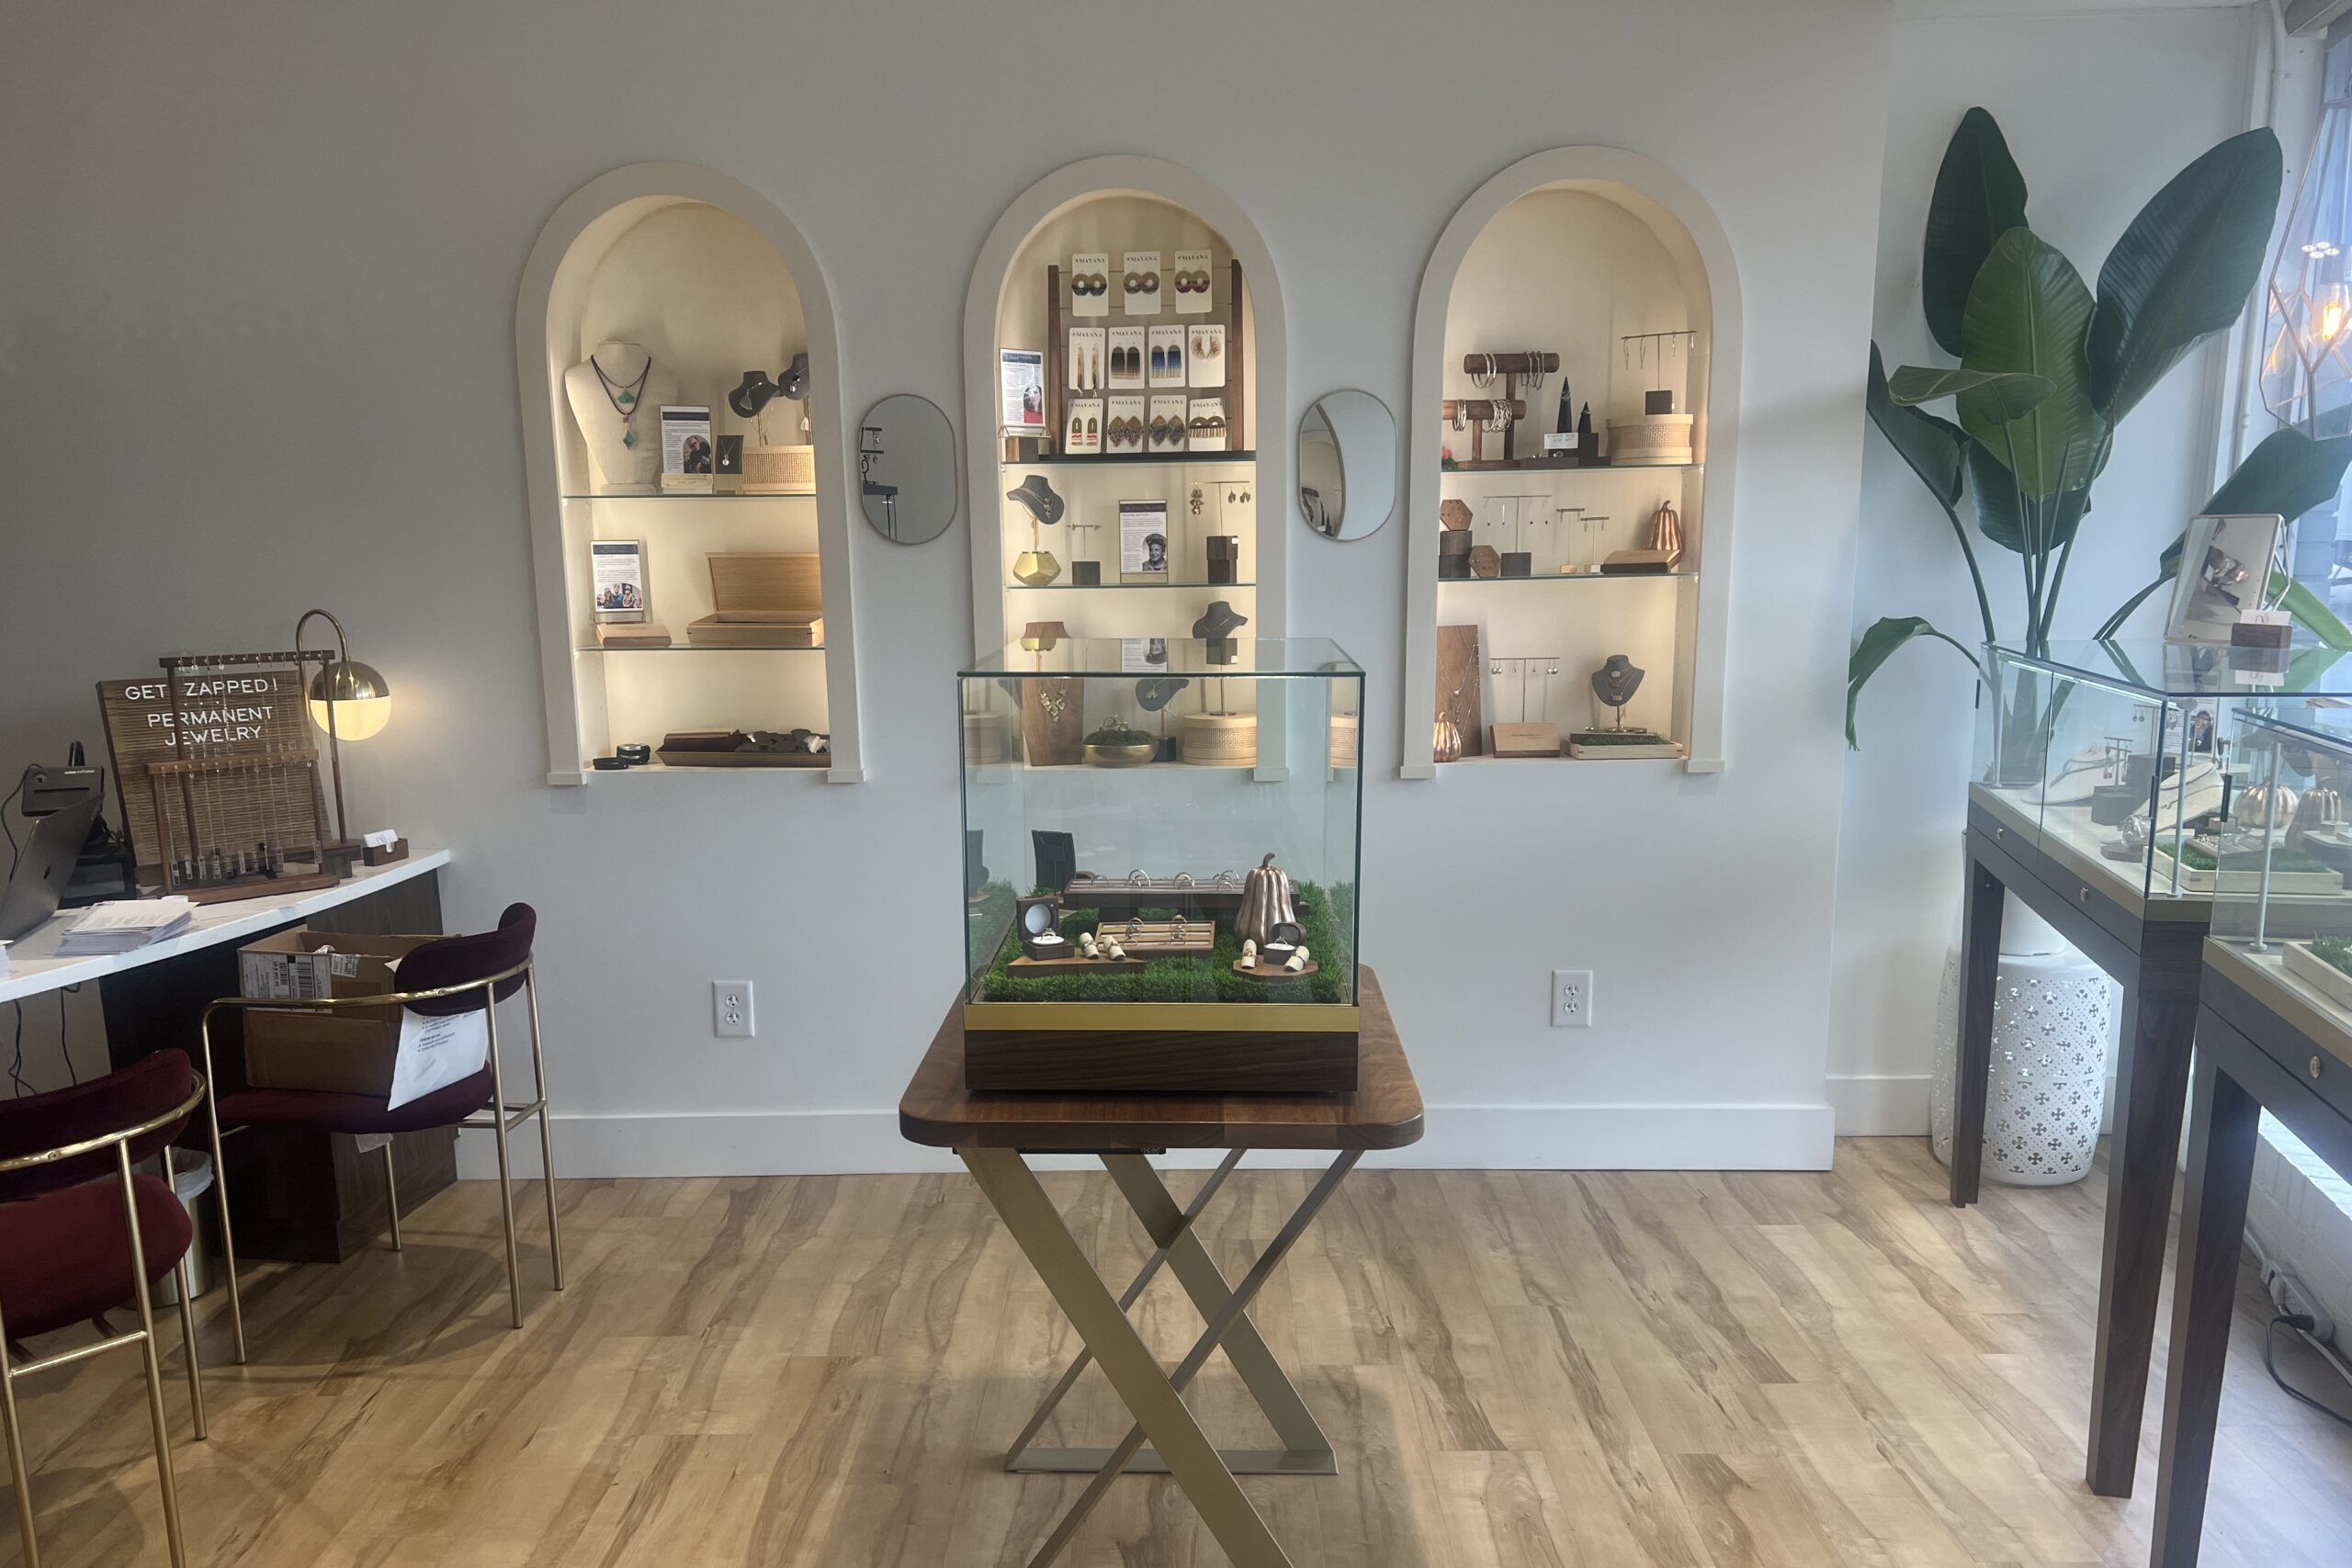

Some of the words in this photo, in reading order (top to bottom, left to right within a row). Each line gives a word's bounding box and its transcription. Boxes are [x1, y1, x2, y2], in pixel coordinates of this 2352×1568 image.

[125, 684, 166, 700] GET
[185, 678, 278, 696] ZAPPED!
[147, 706, 273, 728] PERMANENT
[164, 726, 262, 746] JEWELRY
